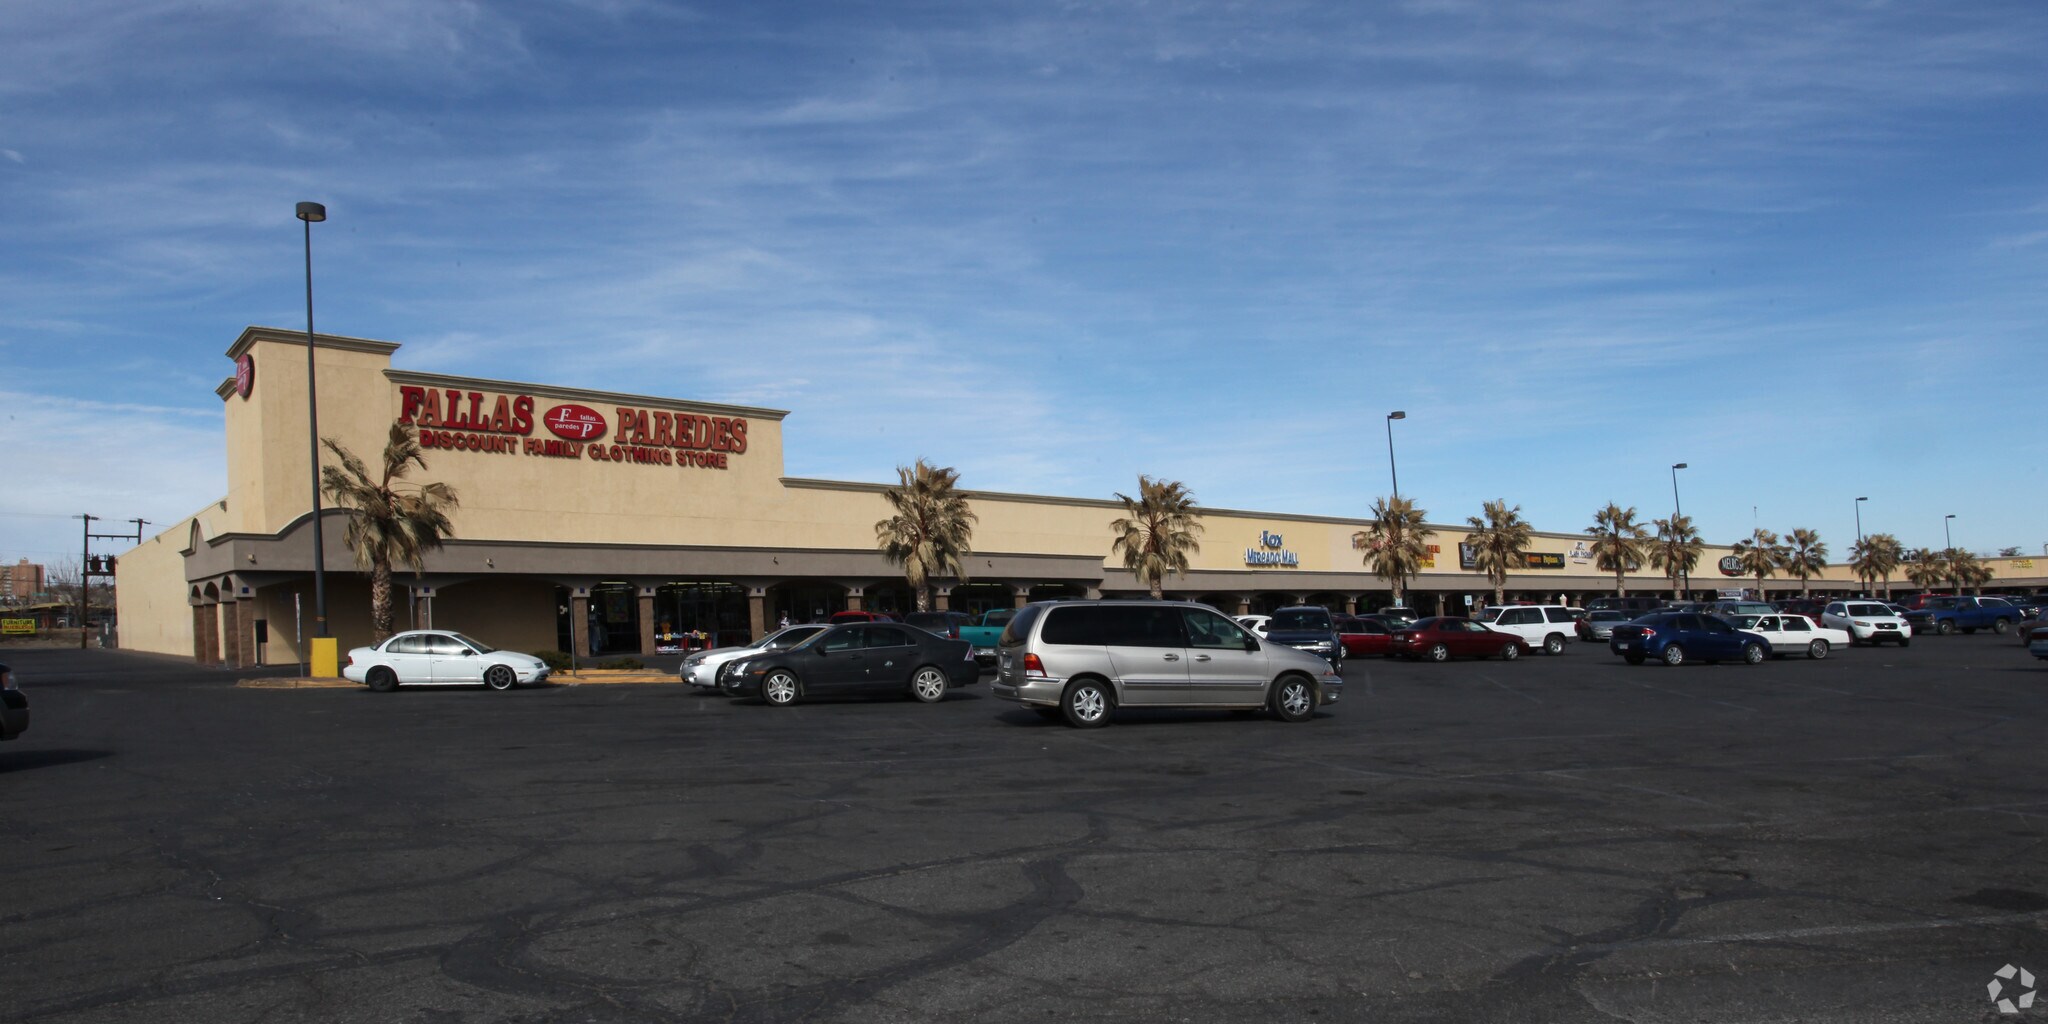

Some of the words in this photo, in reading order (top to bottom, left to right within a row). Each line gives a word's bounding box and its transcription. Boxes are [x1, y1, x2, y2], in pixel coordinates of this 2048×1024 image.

[399, 385, 535, 436] FALLAS
[614, 407, 749, 454] PAREDES
[559, 408, 572, 422] F
[580, 423, 593, 437] P
[419, 429, 518, 455] DISCOUNT
[522, 437, 585, 459] FAMILY
[588, 443, 672, 465] CLOTHING
[676, 450, 728, 469] STORE
